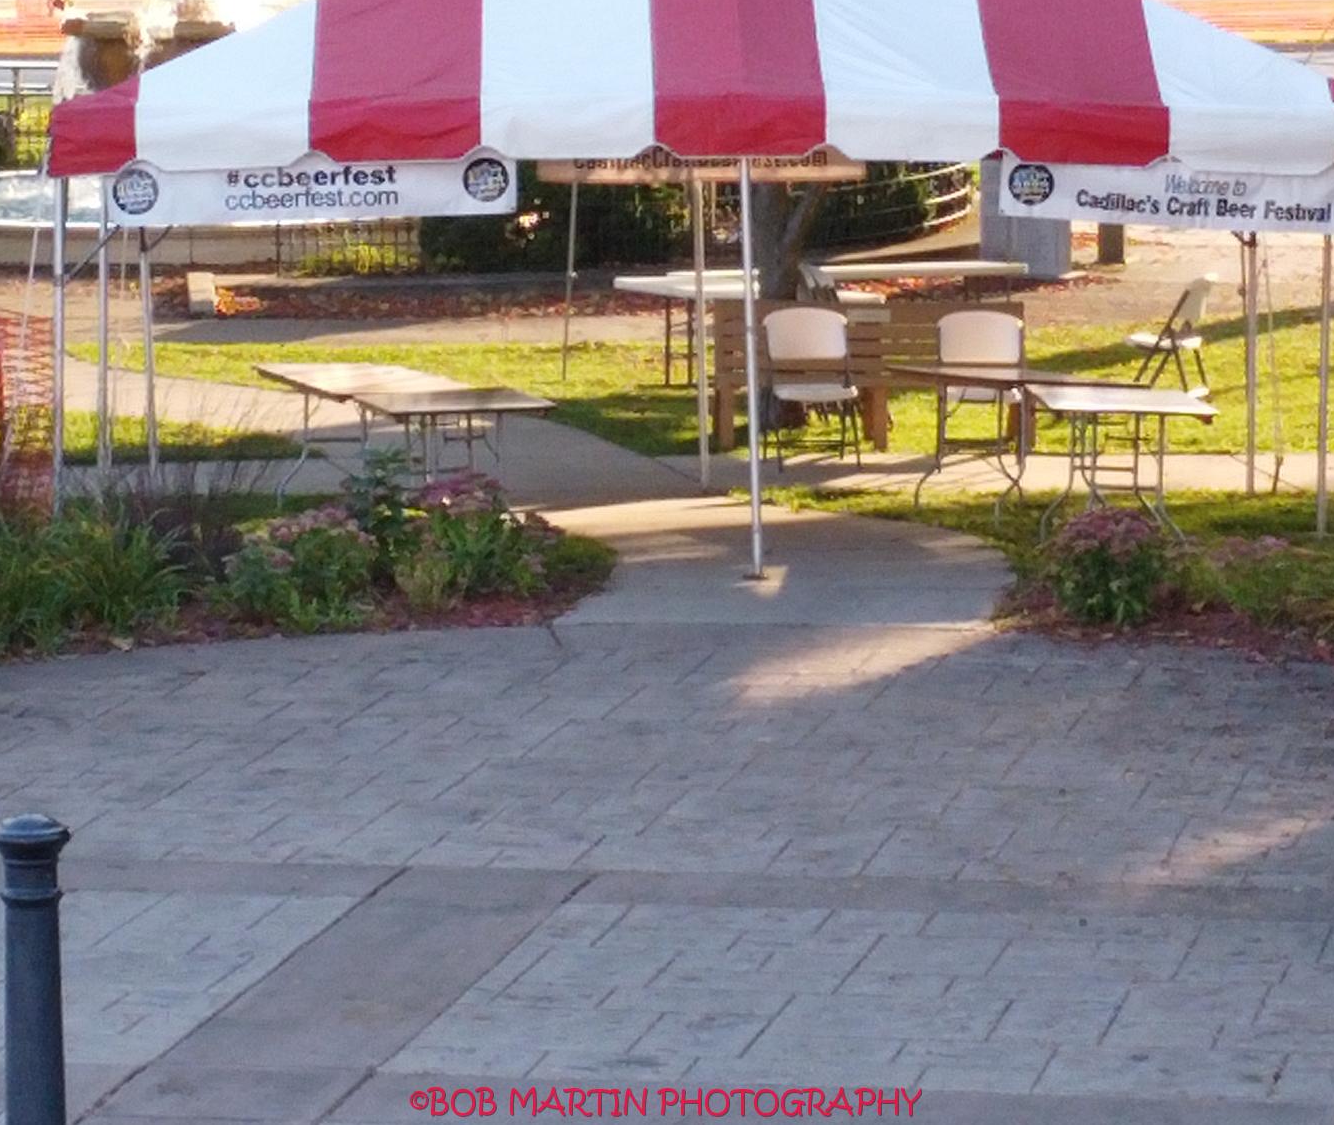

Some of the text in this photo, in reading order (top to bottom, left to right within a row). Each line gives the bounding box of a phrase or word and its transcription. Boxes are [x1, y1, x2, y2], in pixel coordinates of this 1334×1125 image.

[226, 165, 397, 188] #ccbeerfest
[1164, 174, 1248, 197] Welcome to
[224, 188, 399, 211] ccbeerfest.com
[1076, 188, 1160, 215] Cadillac's
[1166, 195, 1211, 217] Craft
[1216, 197, 1257, 219] Beer
[1263, 200, 1332, 223] Festival
